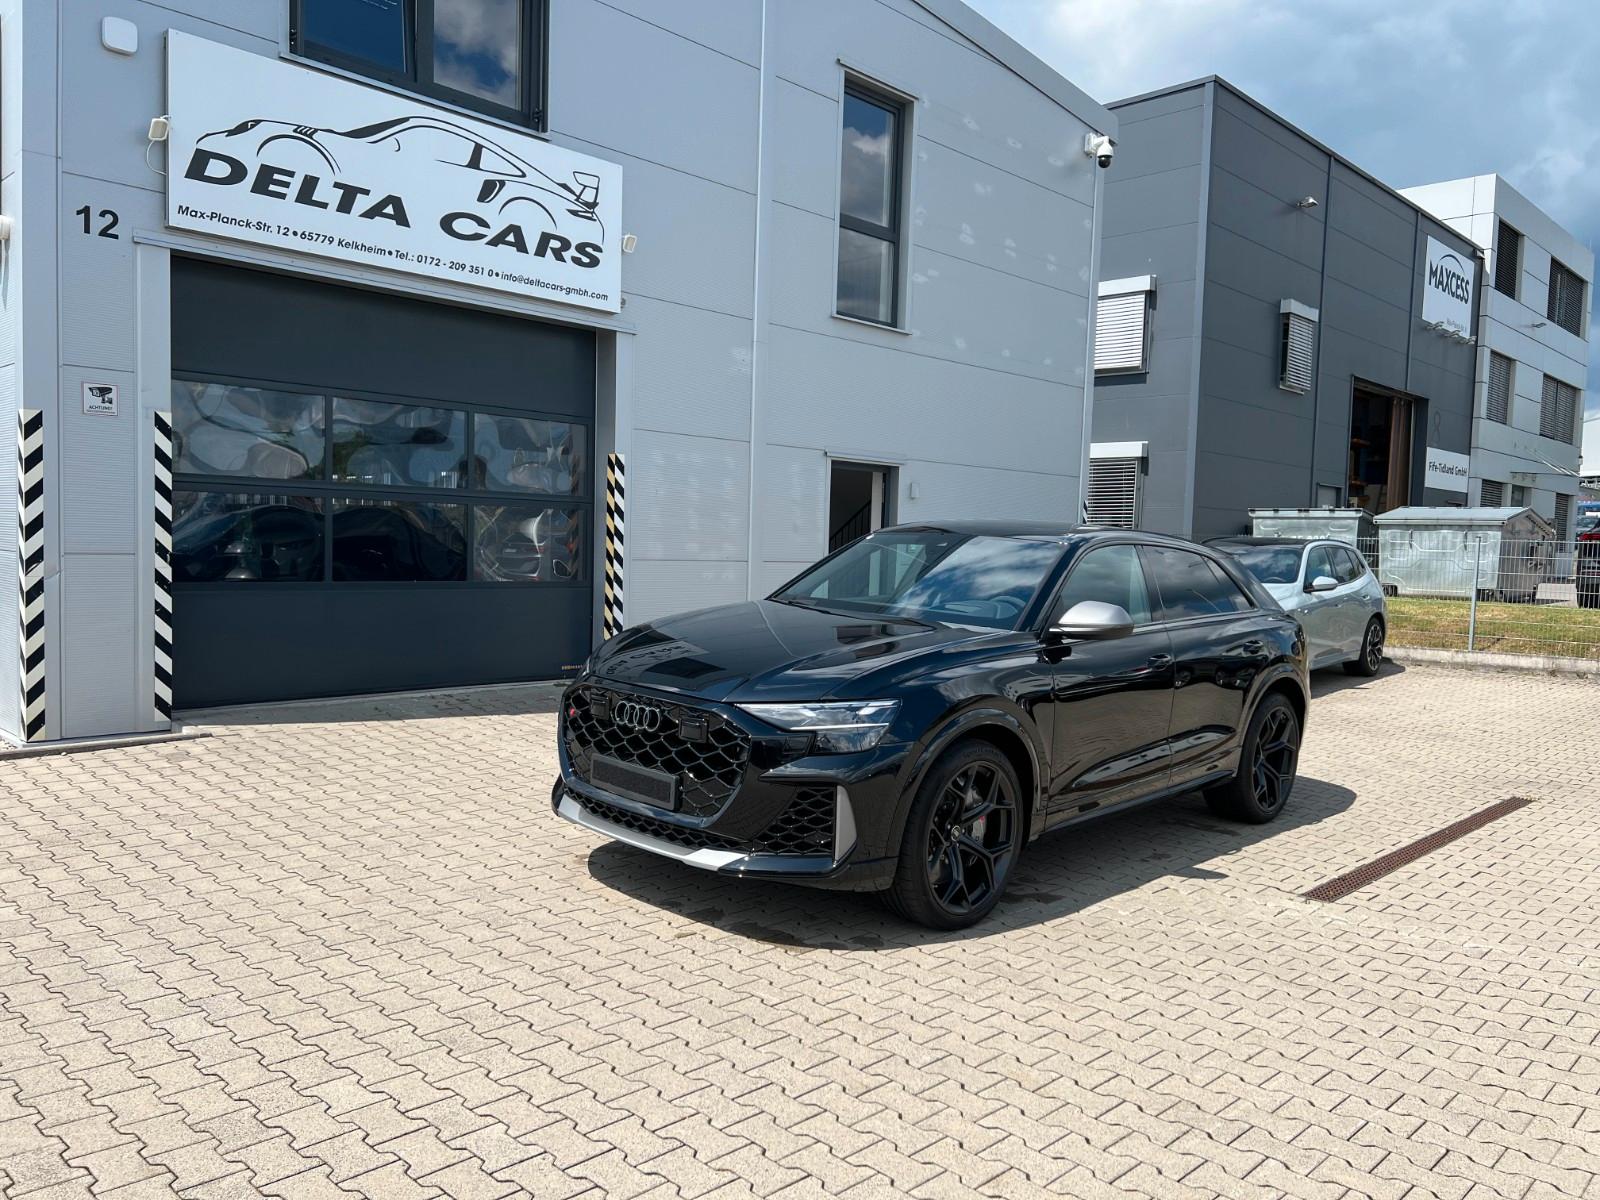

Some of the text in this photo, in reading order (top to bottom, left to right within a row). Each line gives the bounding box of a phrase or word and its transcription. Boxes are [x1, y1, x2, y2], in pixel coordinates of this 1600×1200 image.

[76, 205, 119, 240] 12
[184, 148, 603, 268] DELTA CARS
[177, 205, 272, 233] Max-Planck-Str.
[276, 225, 290, 237] 12
[300, 231, 335, 245] 65779
[337, 238, 386, 256] Kelkheim
[416, 254, 441, 267] 0172
[448, 260, 466, 272] 209
[468, 264, 485, 276] 351
[501, 272, 609, 302] info@deltacars-gmbh.com
[1428, 260, 1470, 304] MAXCESS
[1428, 461, 1468, 477] Fife-Tidland GmbH
